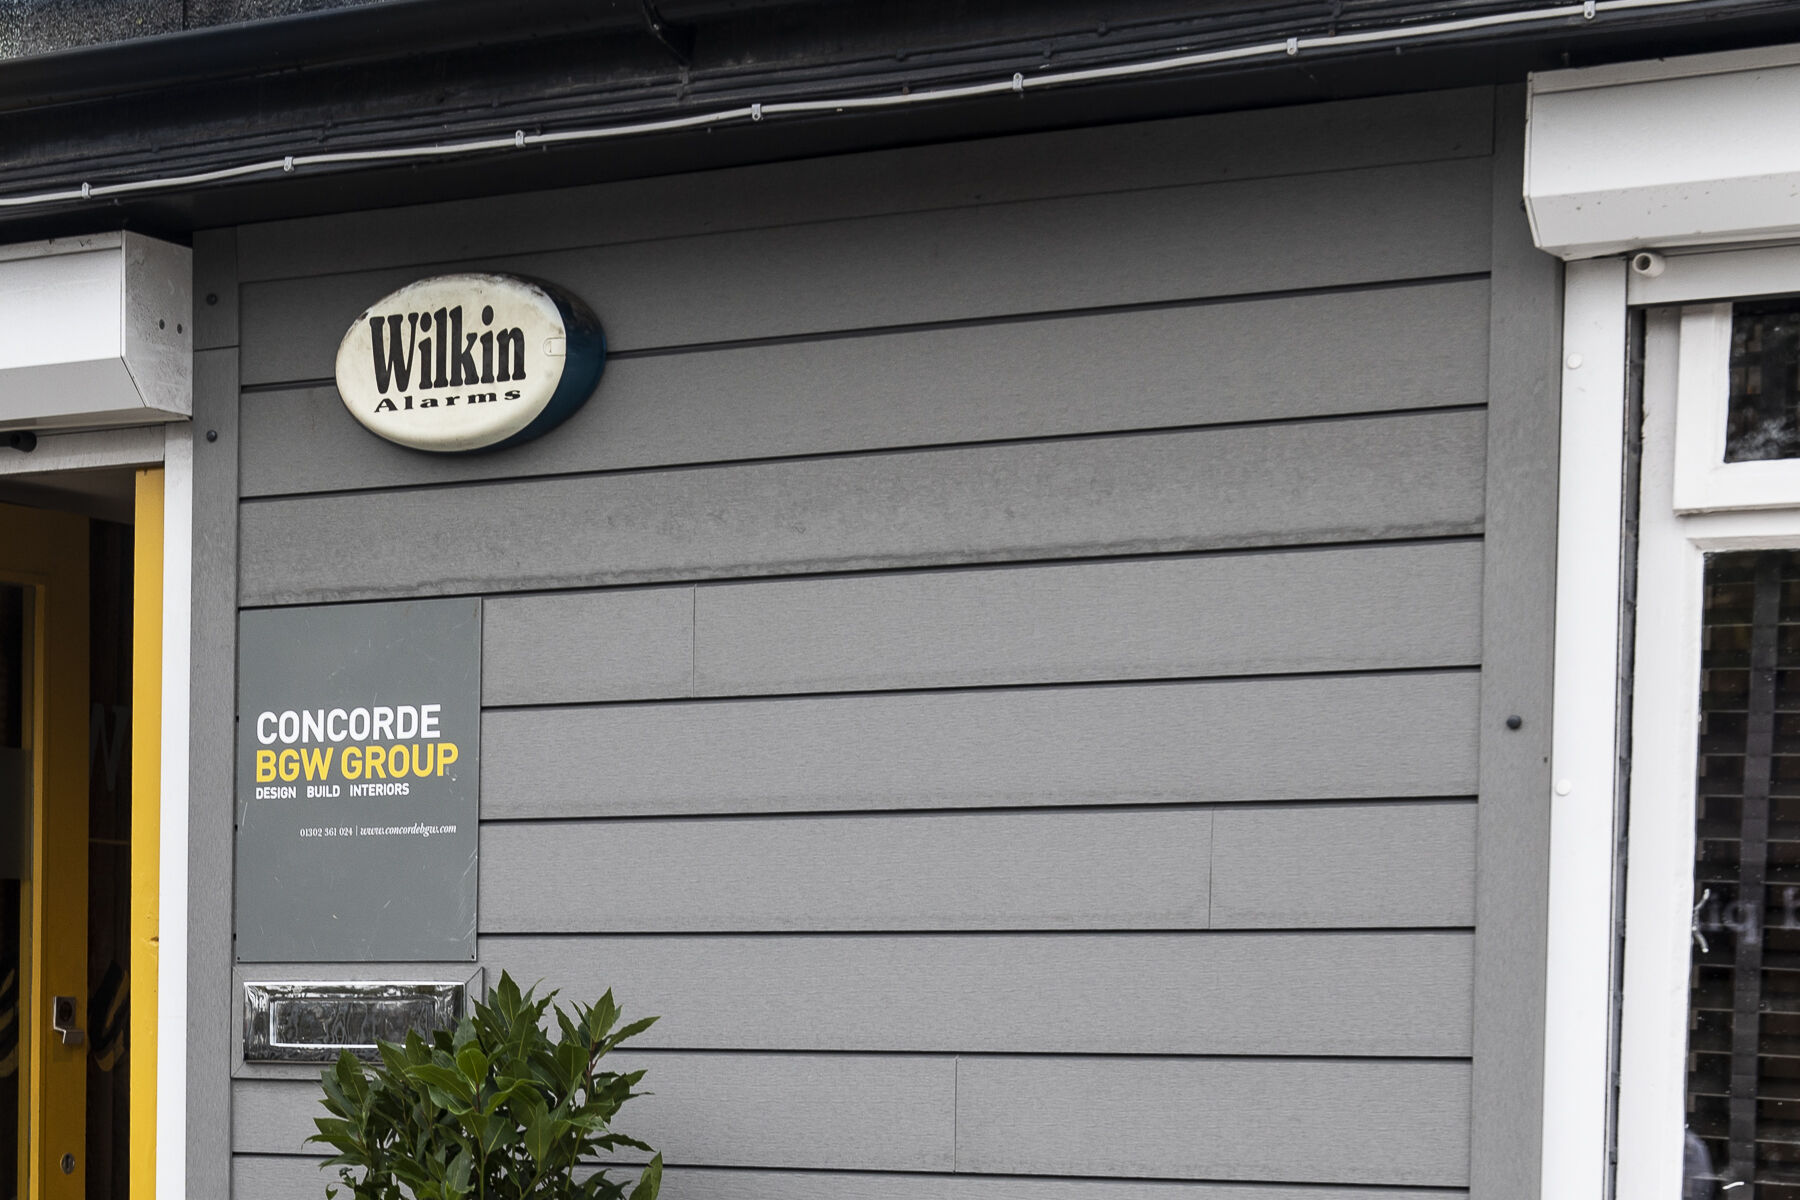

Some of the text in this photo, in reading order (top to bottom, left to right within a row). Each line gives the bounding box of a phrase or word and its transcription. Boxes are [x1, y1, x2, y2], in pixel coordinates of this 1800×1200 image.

[369, 305, 526, 394] Wilkin
[374, 389, 521, 413] Alarms
[256, 704, 441, 744] CONCORDE
[256, 743, 459, 782] BGW GROUP
[255, 782, 410, 800] DESIGN BUILD INTERIORS
[300, 827, 323, 837] 01302
[324, 826, 337, 837] 361
[360, 822, 457, 838] www.concordebgw.com
